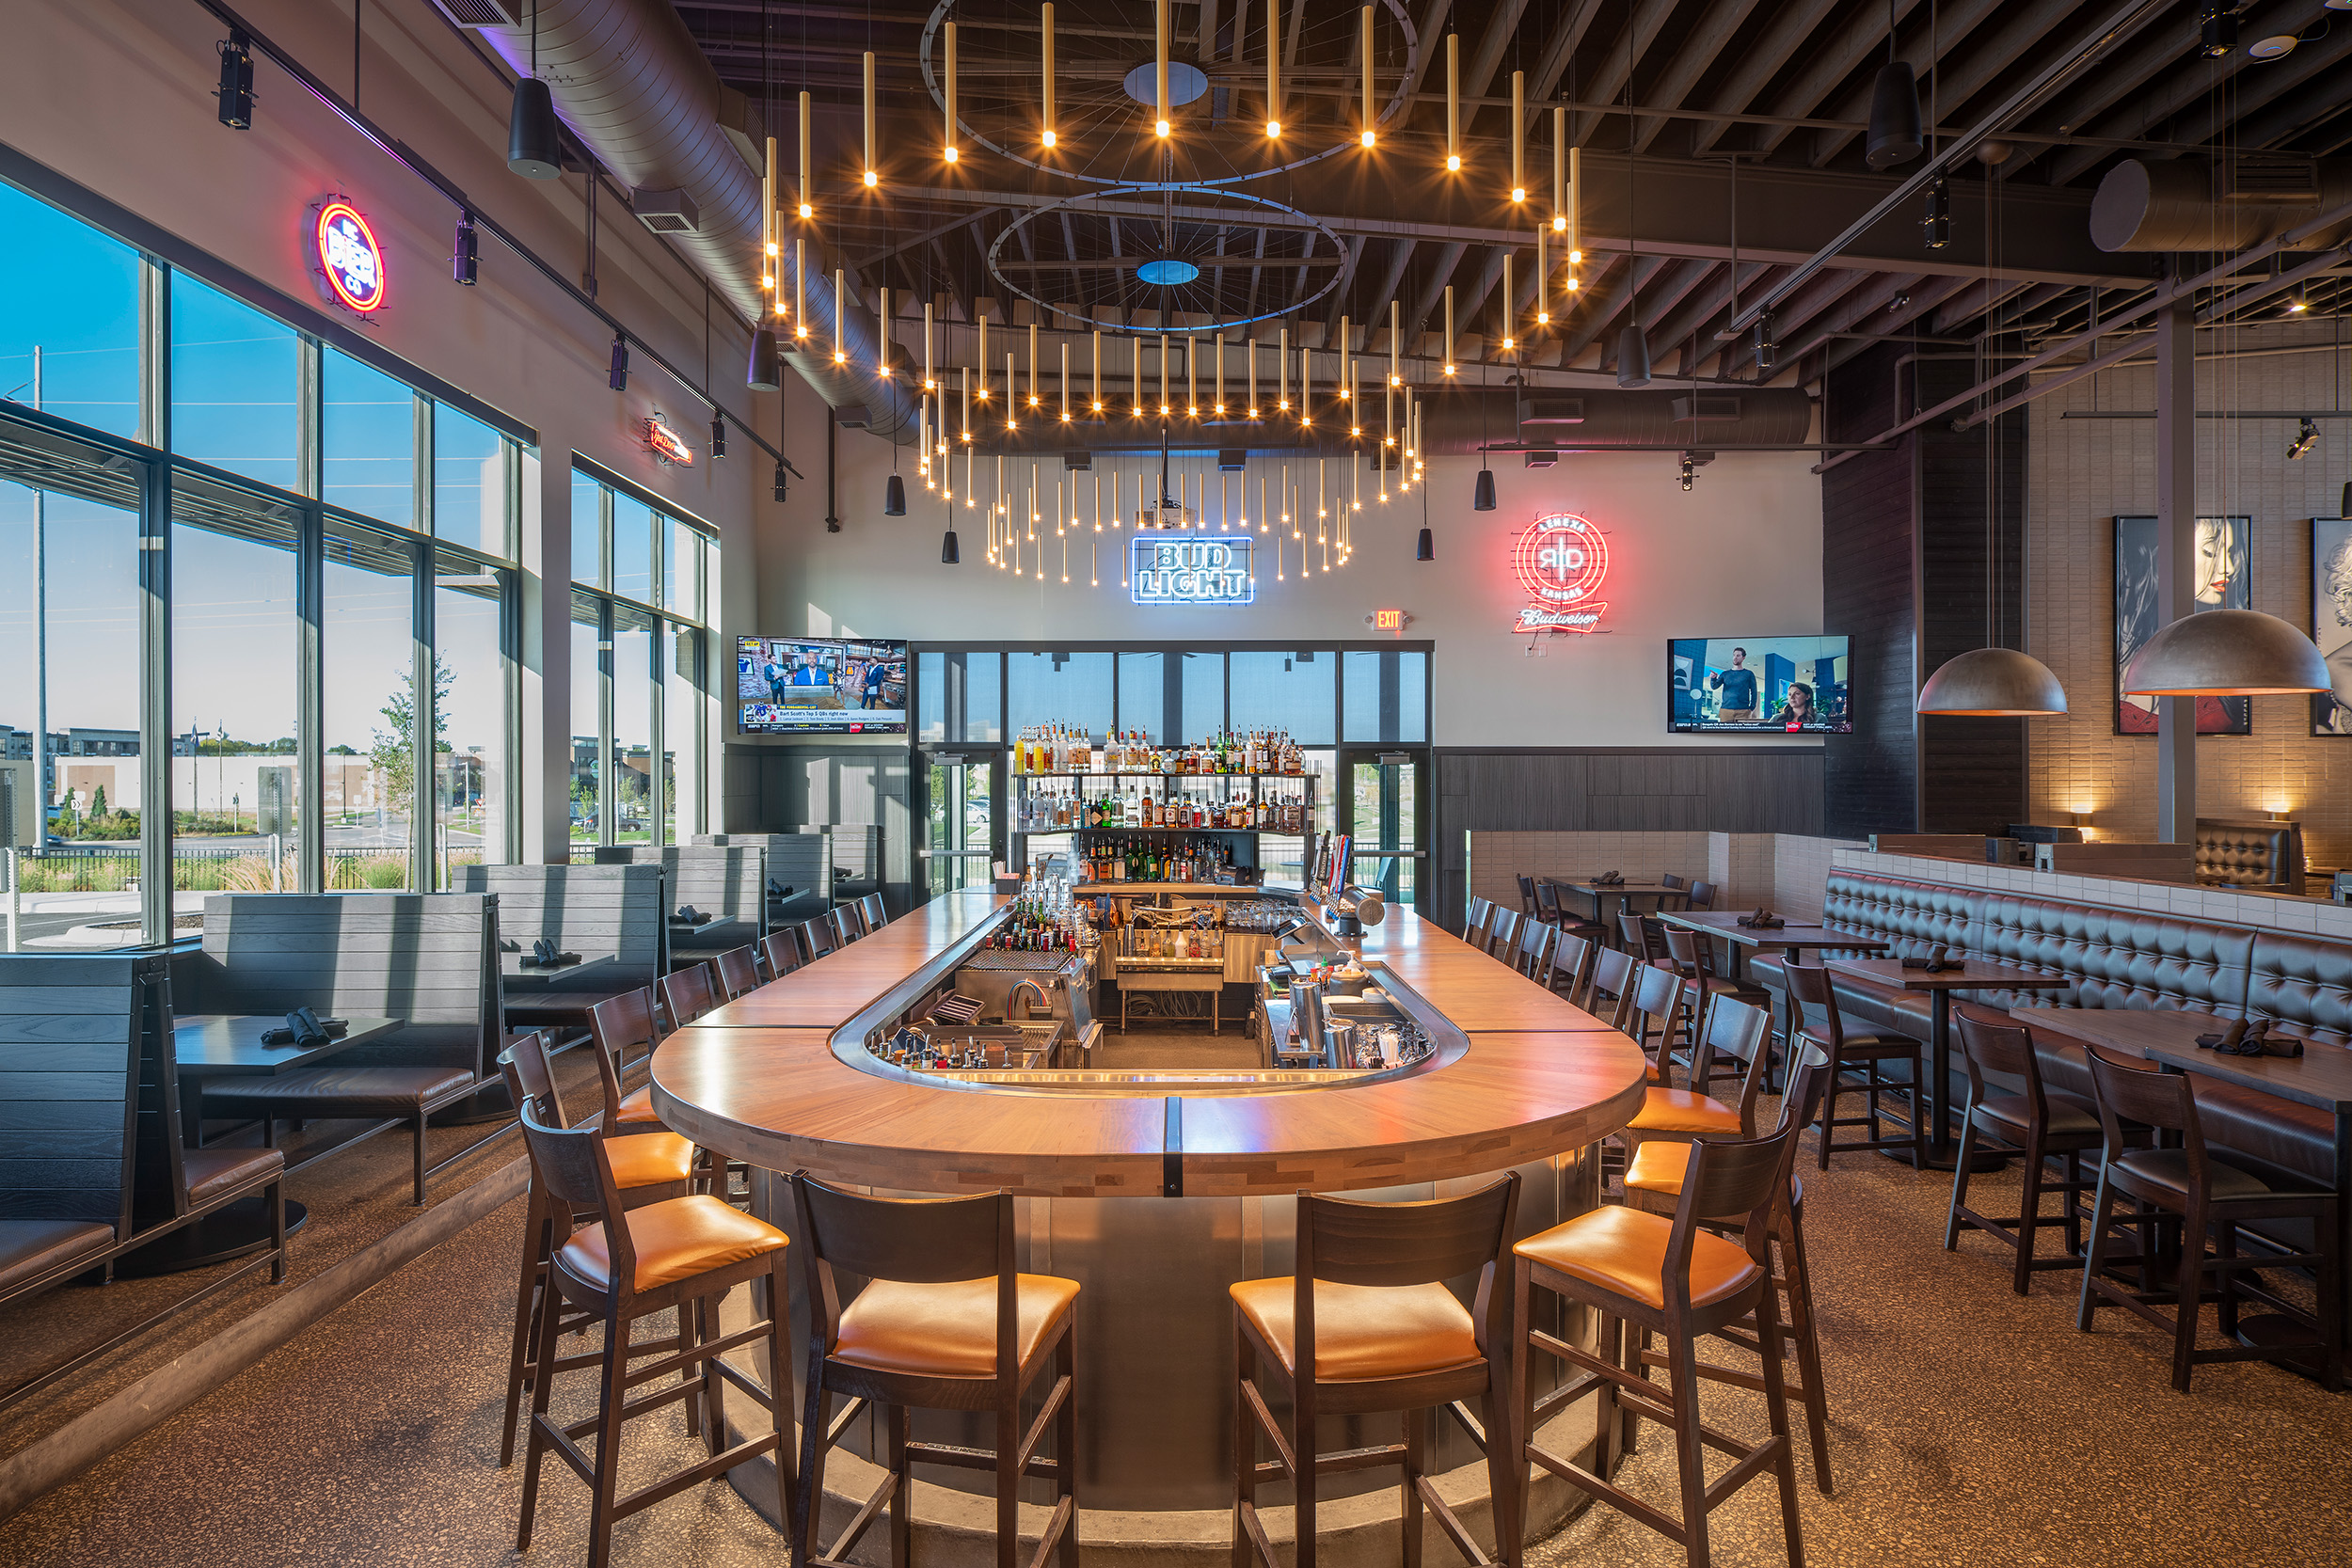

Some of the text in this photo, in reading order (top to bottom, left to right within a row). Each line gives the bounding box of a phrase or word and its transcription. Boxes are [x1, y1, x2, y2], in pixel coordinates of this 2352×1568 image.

[1538, 517, 1586, 533] LENEXA
[1154, 542, 1232, 570] BUD
[1139, 569, 1247, 598] LIGHT
[1540, 586, 1583, 601] KANSAS
[1377, 610, 1400, 627] EXIT
[1520, 609, 1600, 626] Budweiser
